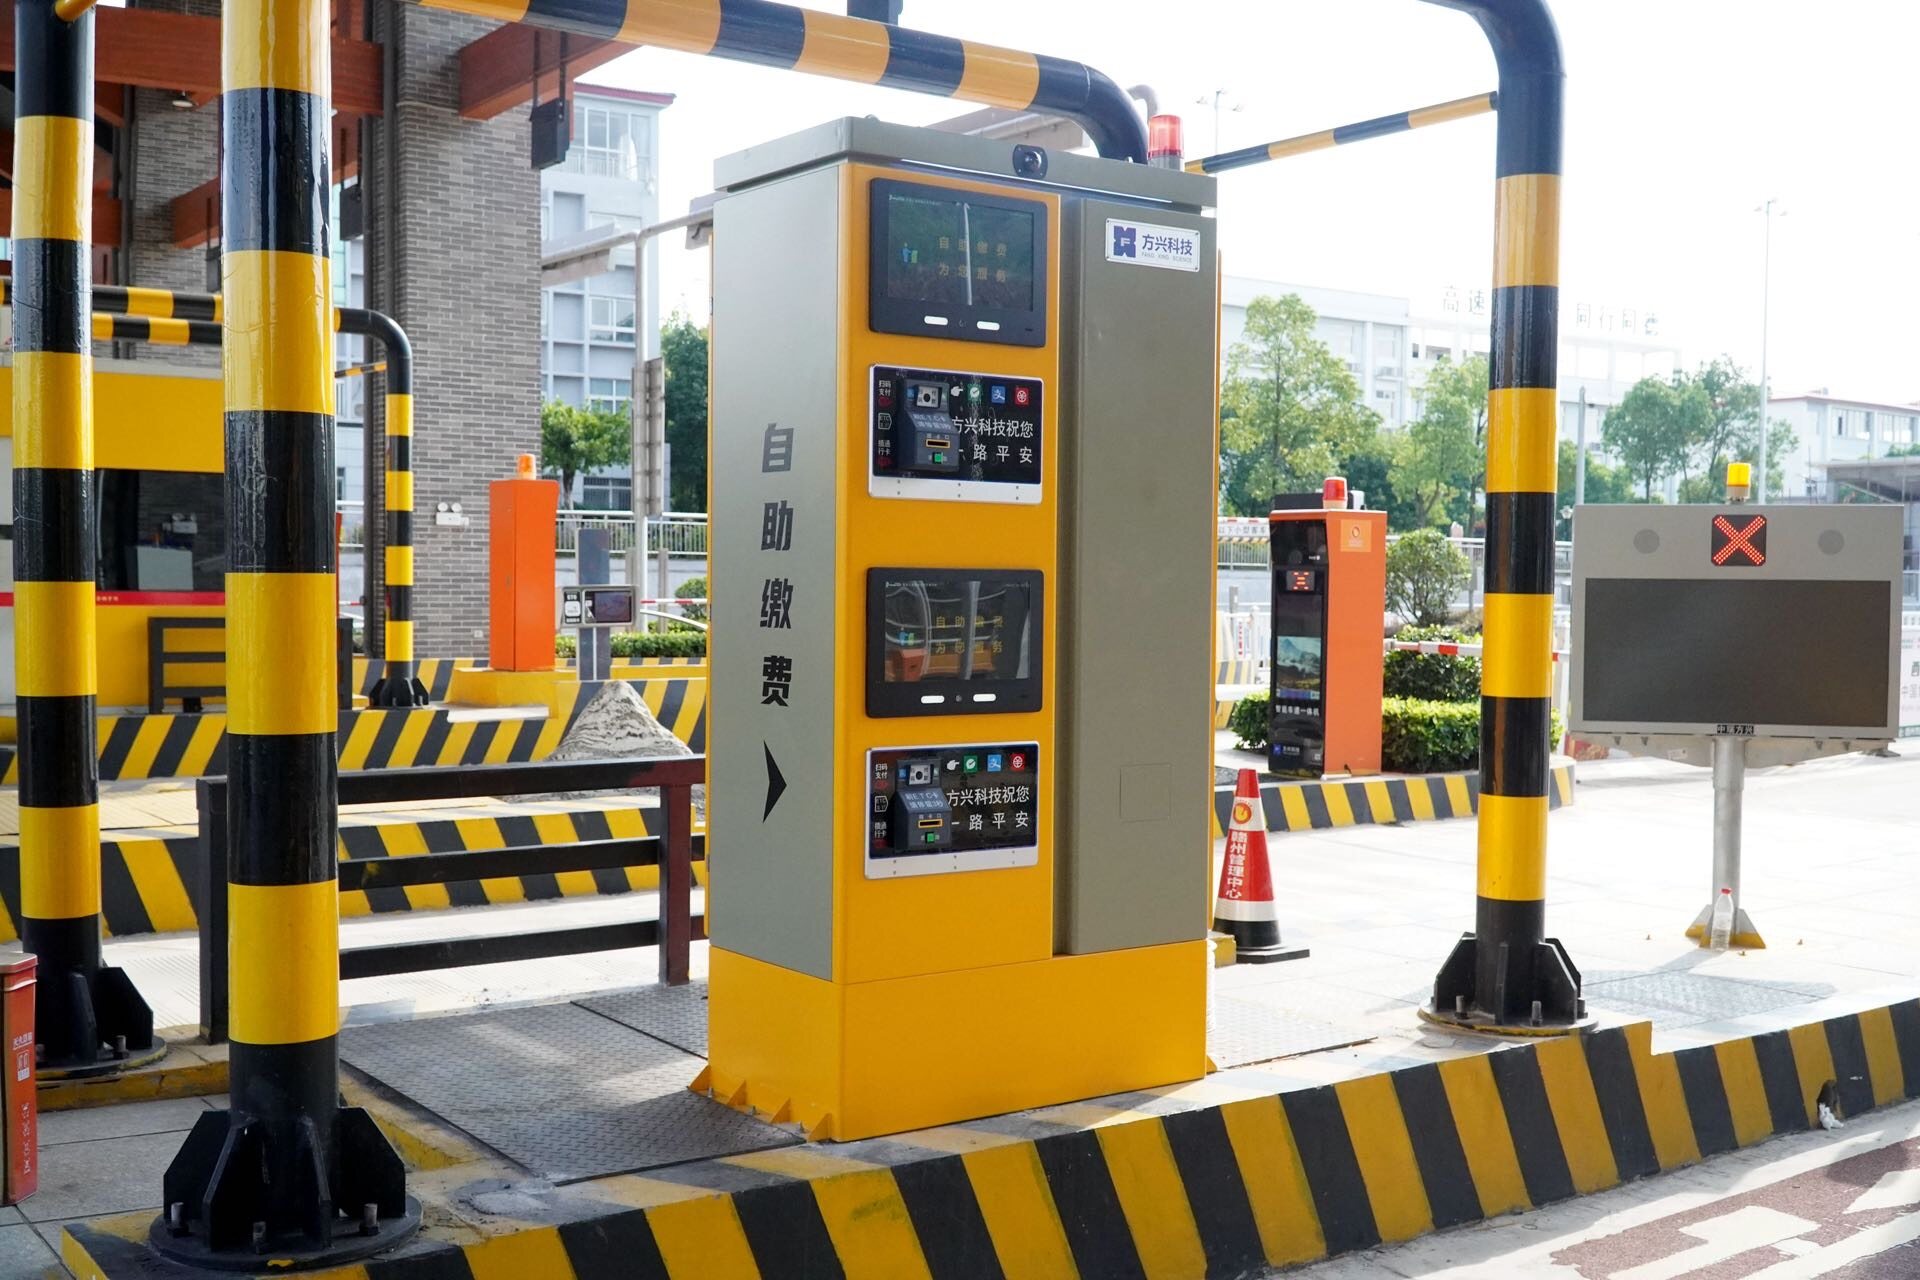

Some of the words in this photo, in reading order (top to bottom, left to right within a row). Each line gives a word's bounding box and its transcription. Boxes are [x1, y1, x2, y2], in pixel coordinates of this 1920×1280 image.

[1142, 234, 1192, 256] 方兴科技
[759, 422, 794, 706] 自助缴费
[947, 785, 1030, 806] 方兴科技祝您
[951, 811, 1029, 831] 一路平安
